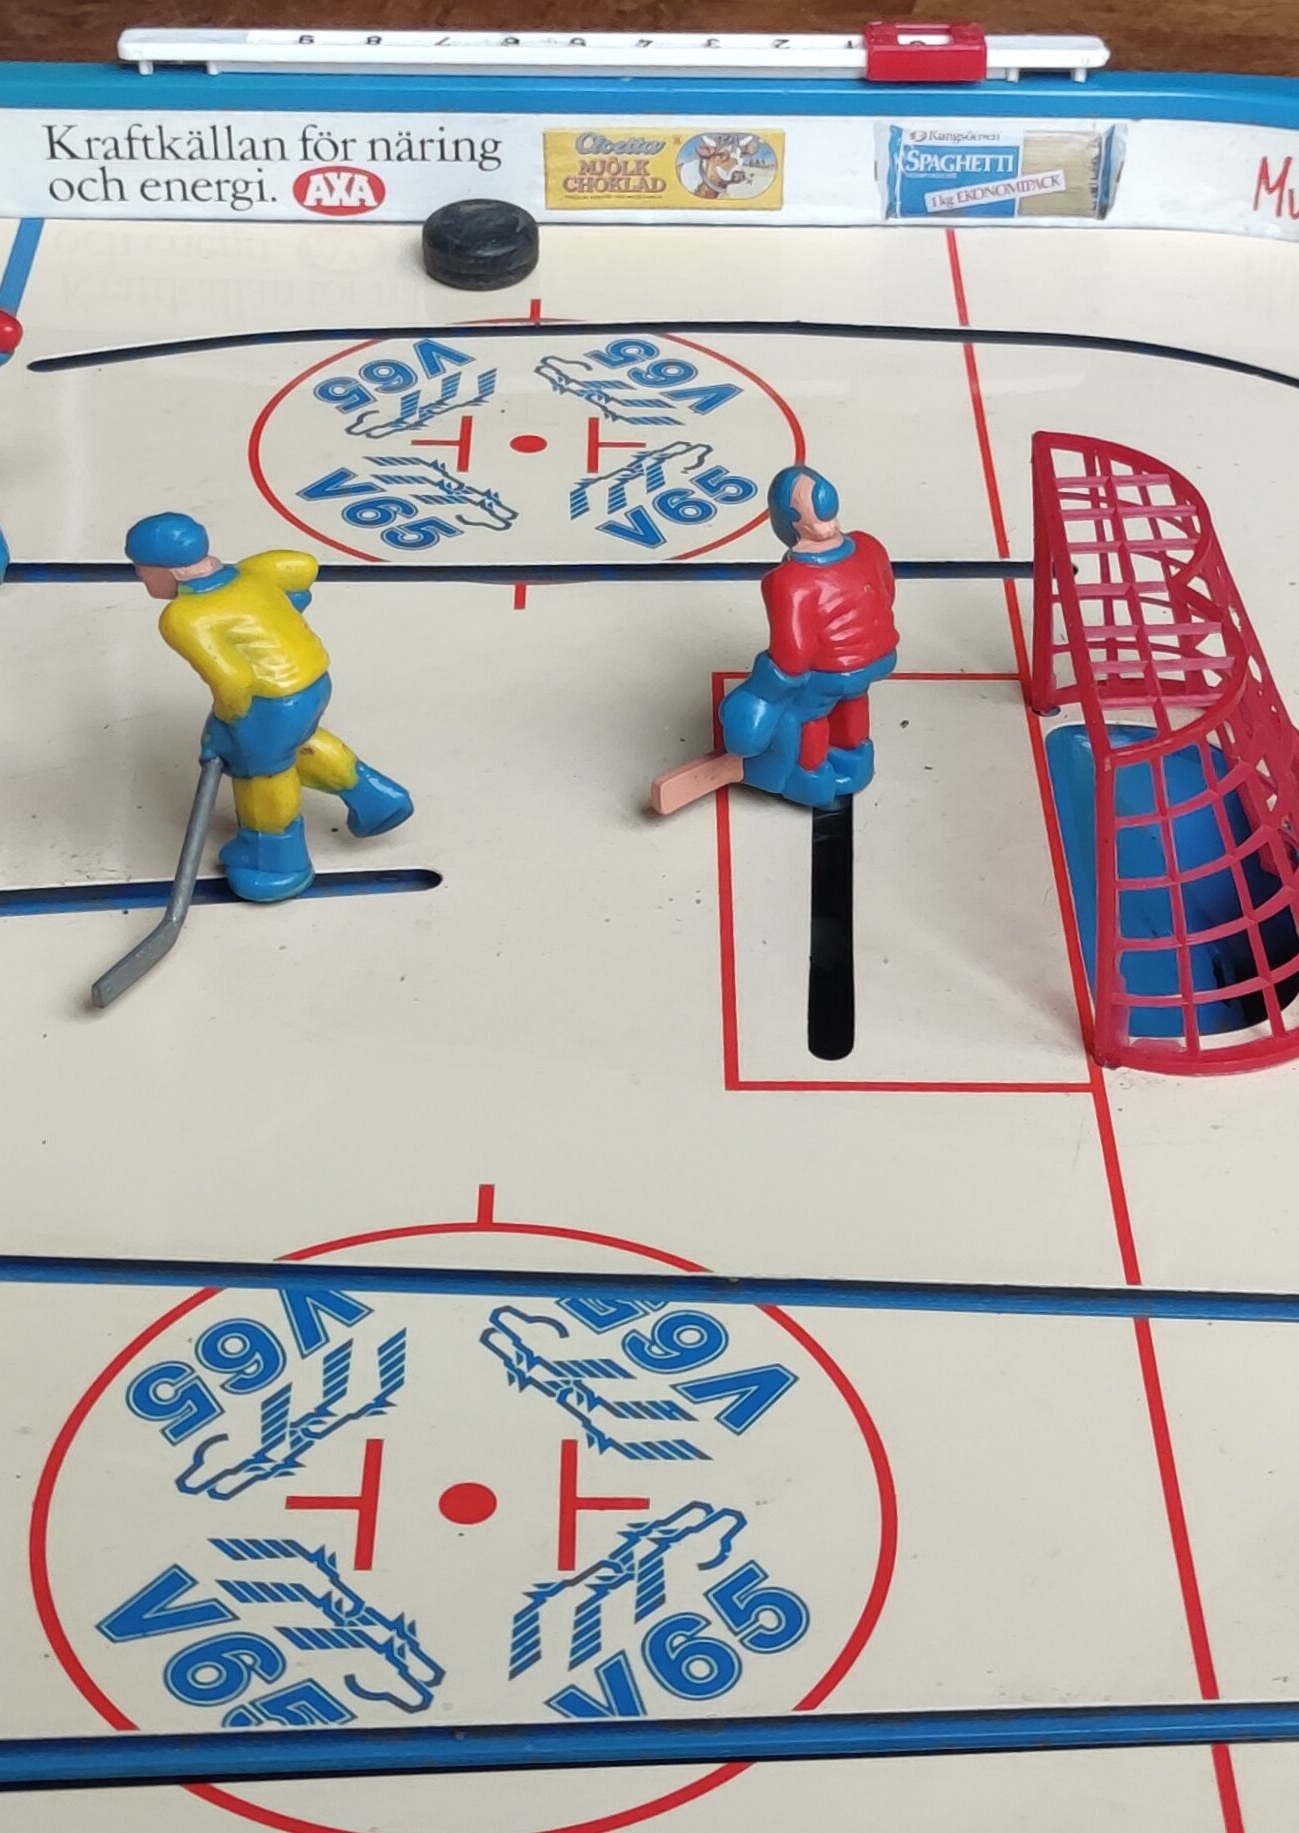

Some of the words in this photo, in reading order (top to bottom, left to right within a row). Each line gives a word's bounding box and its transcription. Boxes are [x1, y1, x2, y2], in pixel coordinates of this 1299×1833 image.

[366, 35, 382, 45] 8
[42, 123, 289, 161] Kraftkällan
[300, 124, 357, 162] för
[368, 126, 503, 172] näring
[578, 156, 651, 176] MJÖLK
[904, 150, 1015, 173] SPAGHETTI
[49, 165, 126, 202] och
[140, 168, 277, 212] energi.
[304, 171, 379, 208] AXA
[562, 175, 667, 193] CHOKLAD
[931, 196, 939, 208] 1
[939, 193, 955, 209] kg
[956, 174, 1062, 204] EKONOMIPACK
[313, 338, 475, 415] V65
[583, 338, 744, 415] V65
[296, 467, 465, 551] V65
[596, 464, 759, 549] V65
[545, 1559, 810, 1719] V65
